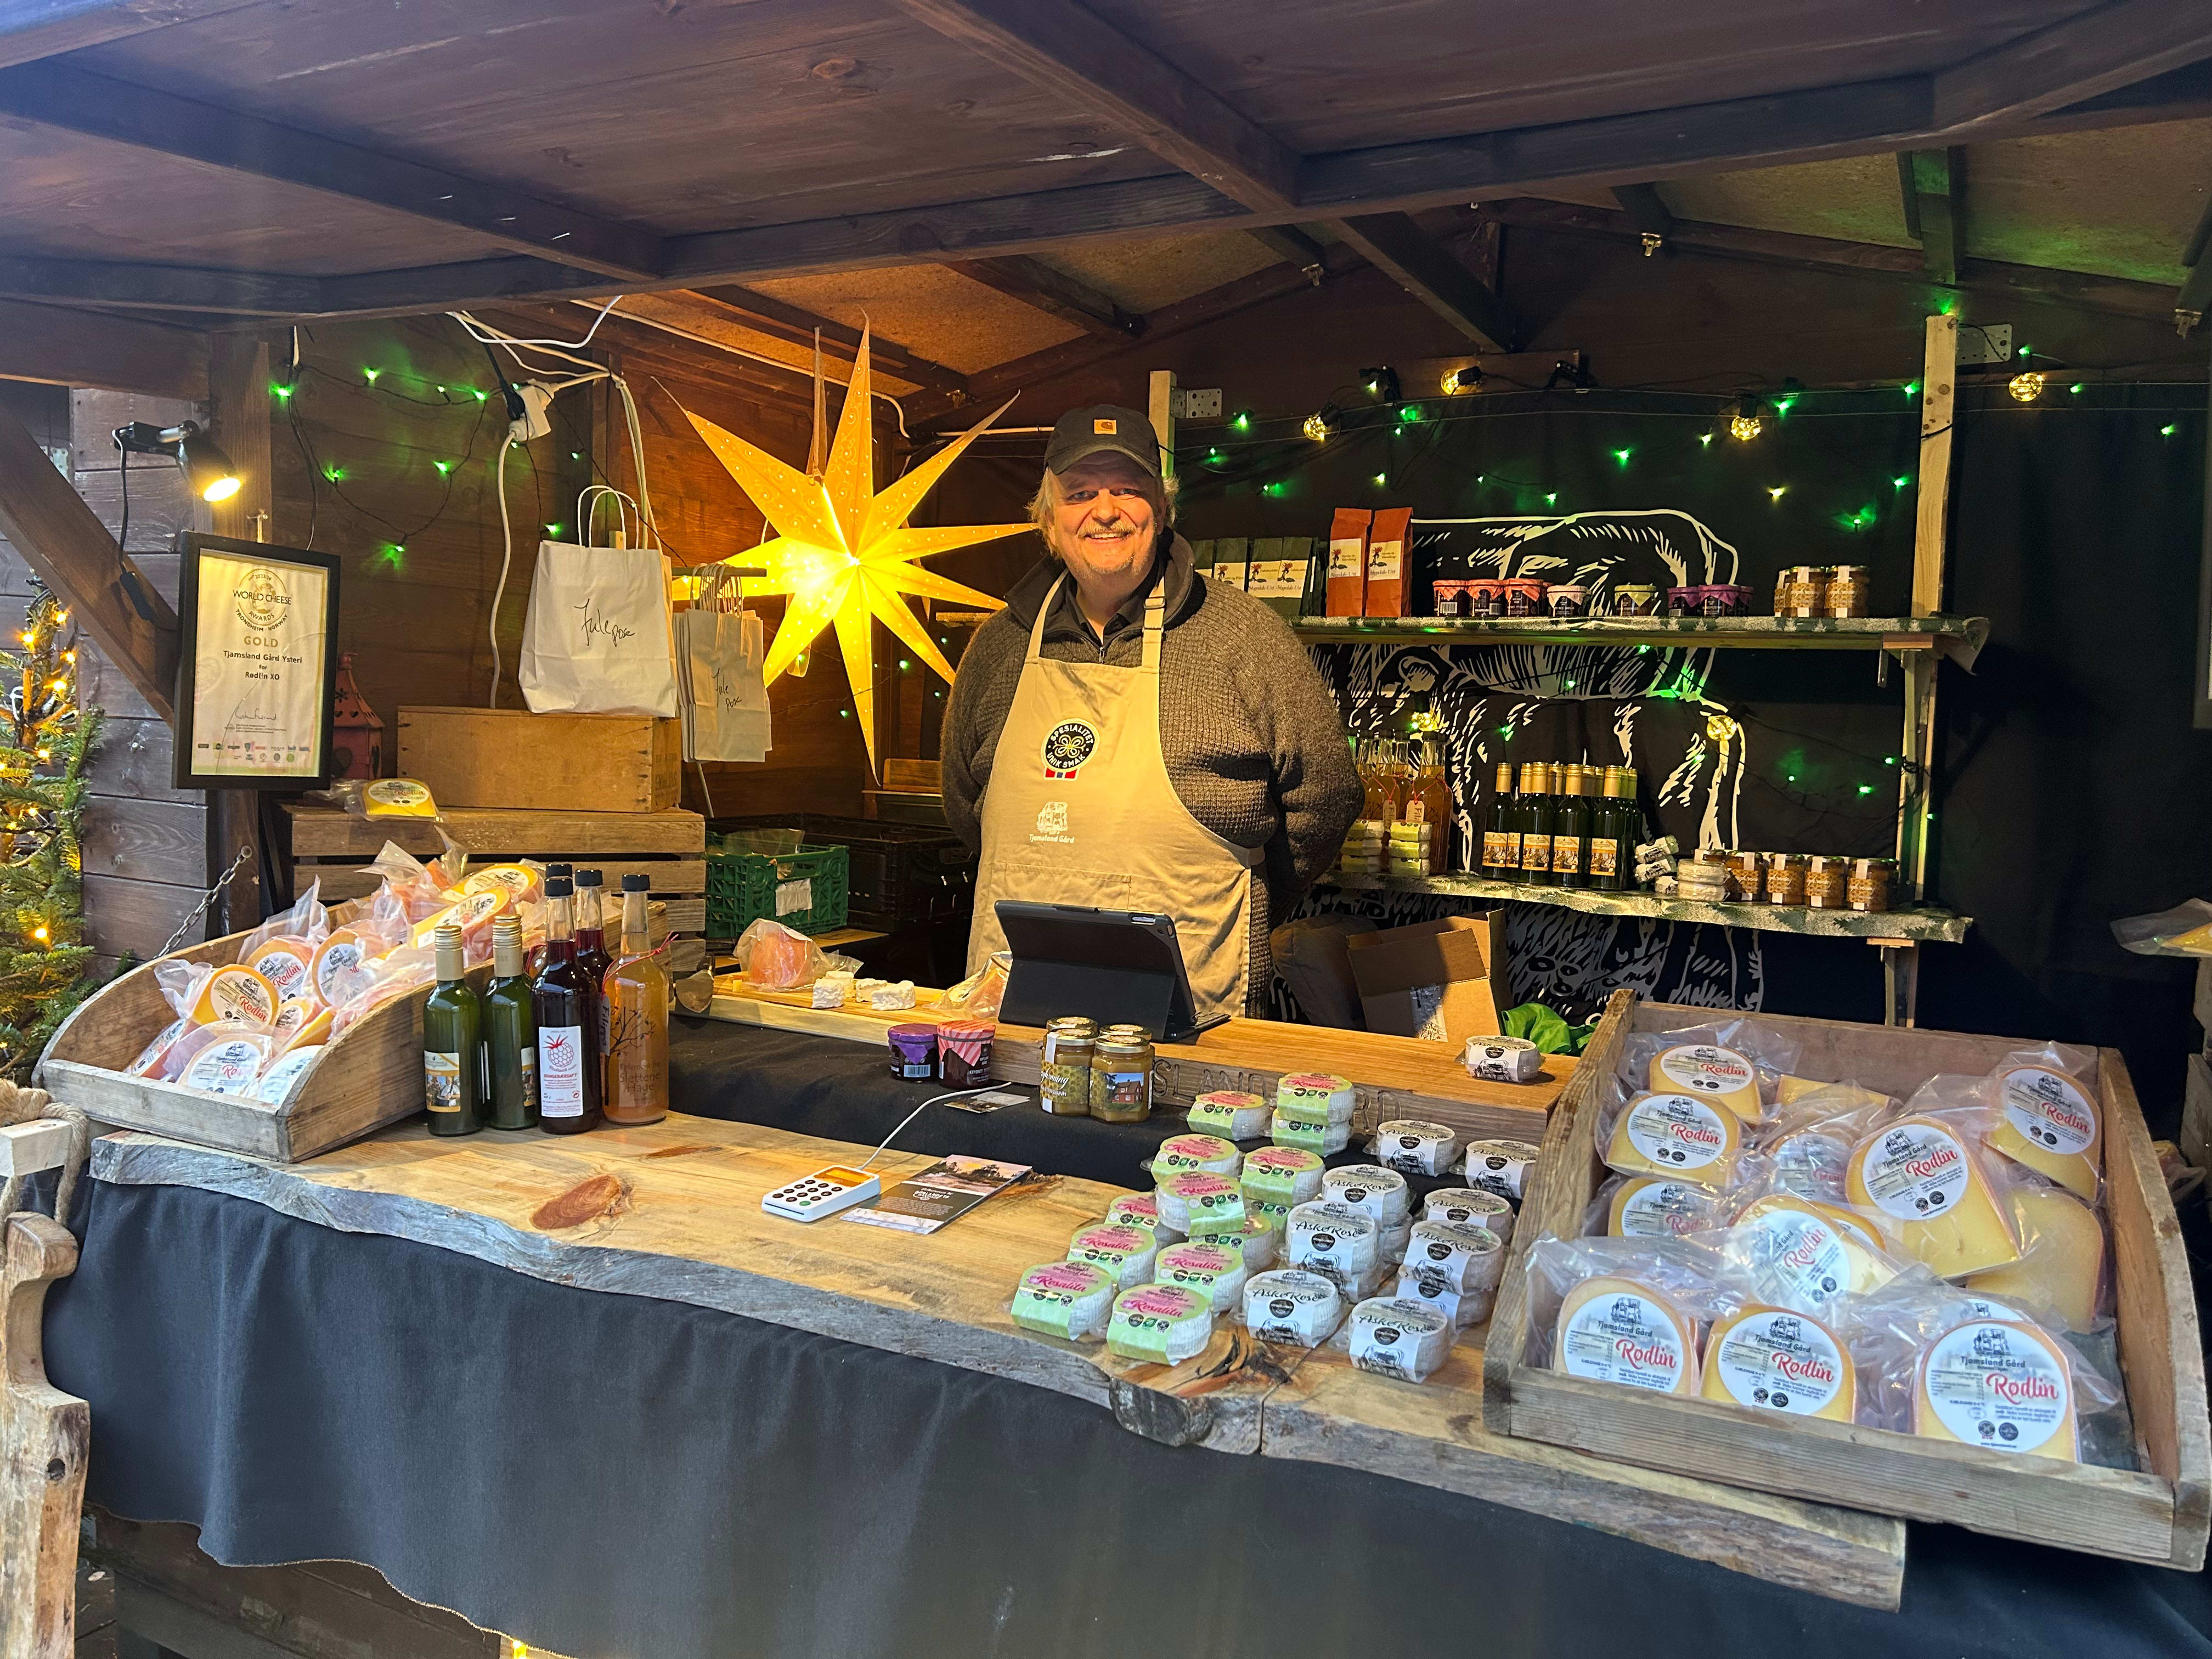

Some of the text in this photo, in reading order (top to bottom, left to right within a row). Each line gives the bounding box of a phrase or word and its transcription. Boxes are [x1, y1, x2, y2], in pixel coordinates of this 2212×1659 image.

[233, 589, 292, 605] WORLD CHEESE
[235, 608, 289, 632] TRONDHEIM NORWAY
[249, 611, 275, 622] AWARDS
[244, 635, 279, 648] GOLD
[223, 650, 302, 664] Tjamsland Gård Ysteri
[1049, 724, 1093, 744] SPESIALITET
[1046, 752, 1086, 768] UNIK SMAK
[1029, 833, 1058, 843] Tjamsland
[627, 1082, 655, 1095] Hage
[1882, 1143, 1928, 1168] Tjamsland Gård
[1174, 1256, 1224, 1271] Rosalita
[1037, 1276, 1087, 1293] Rosalita
[1131, 1300, 1183, 1318] Rosalita
[1597, 1321, 1654, 1338] Tjamsland Gård
[1755, 1334, 1812, 1353] Tjamsland Gård
[1960, 1356, 2026, 1369] Tjamsland Gård
